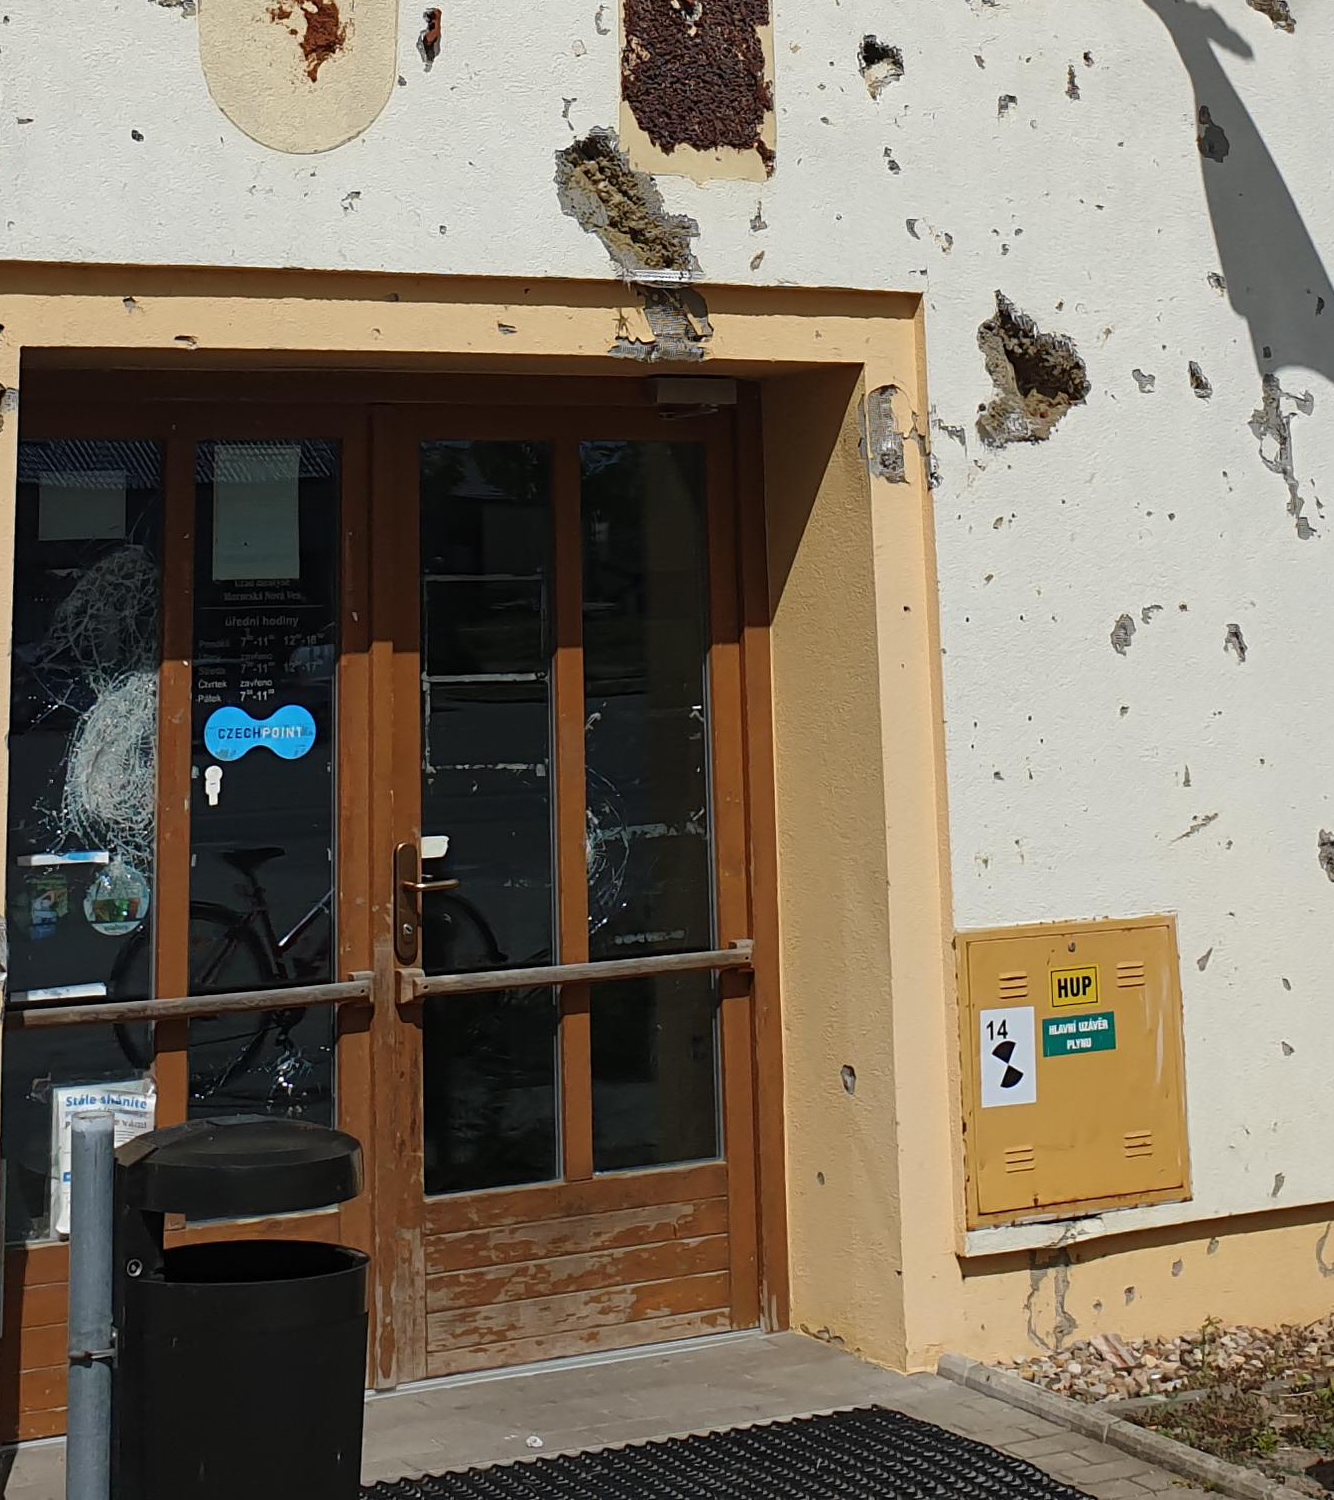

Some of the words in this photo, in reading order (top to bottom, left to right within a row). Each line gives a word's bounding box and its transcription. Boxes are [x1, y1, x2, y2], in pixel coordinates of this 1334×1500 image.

[262, 615, 299, 628] hodiny
[1057, 975, 1092, 998] HUP
[986, 1019, 1008, 1041] 14
[1048, 1020, 1077, 1036] HLAVNÍ
[1078, 1016, 1109, 1033] UZÁVĚR
[1066, 1037, 1092, 1050] PLYNU
[65, 1094, 97, 1108] Stále
